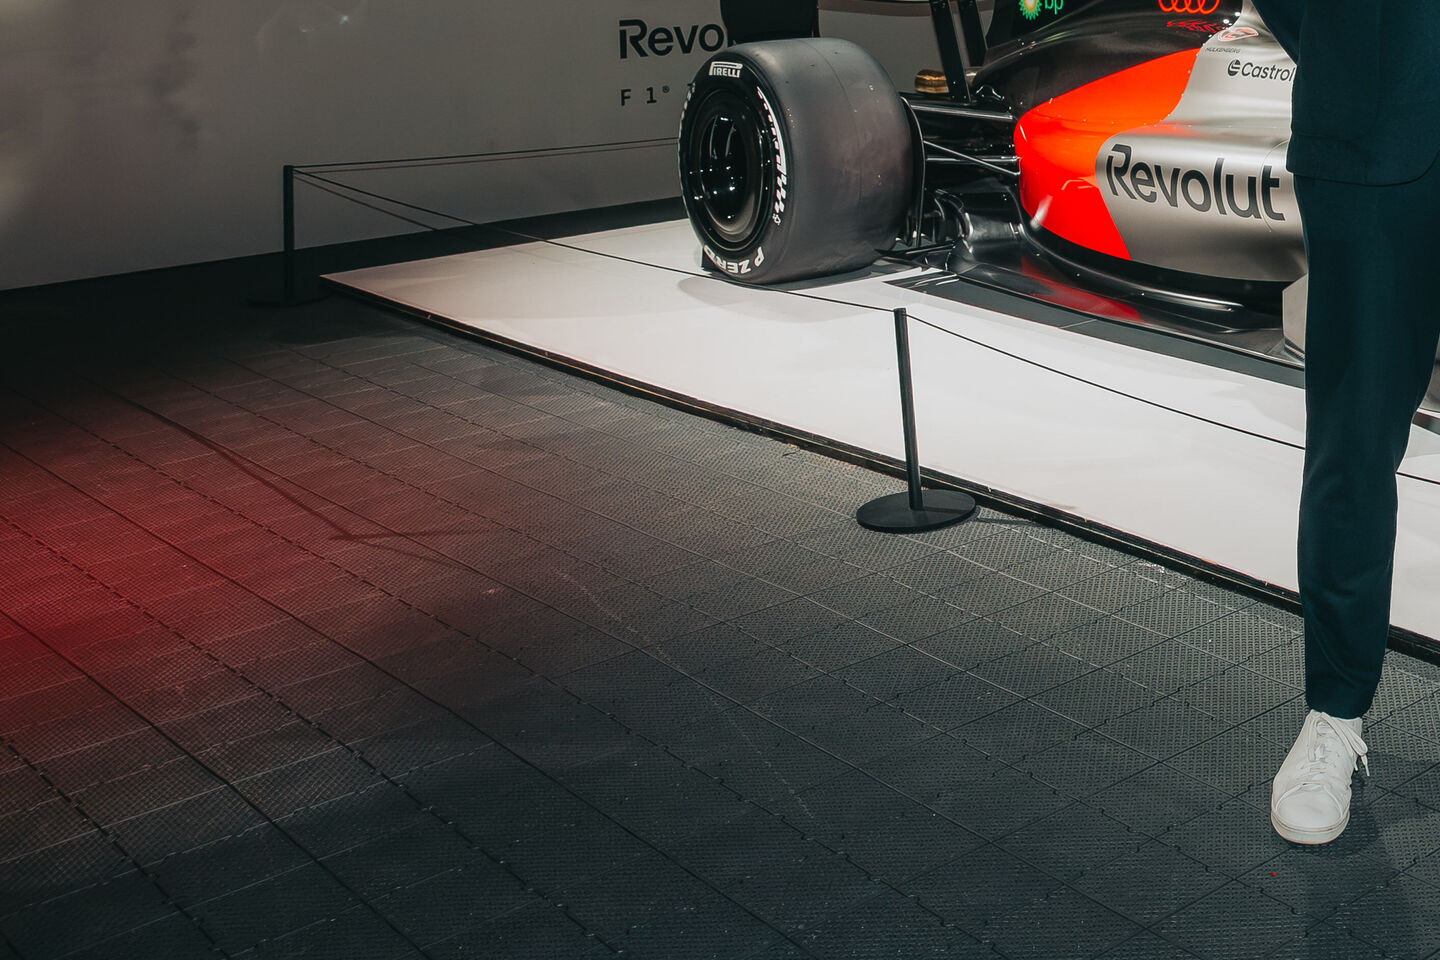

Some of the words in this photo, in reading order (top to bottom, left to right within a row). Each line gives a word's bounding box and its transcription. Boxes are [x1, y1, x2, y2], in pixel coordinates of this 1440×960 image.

[708, 61, 743, 78] PIRELLI
[1241, 62, 1296, 82] Castrol
[1106, 143, 1286, 221] Revolut
[754, 246, 765, 267] P
